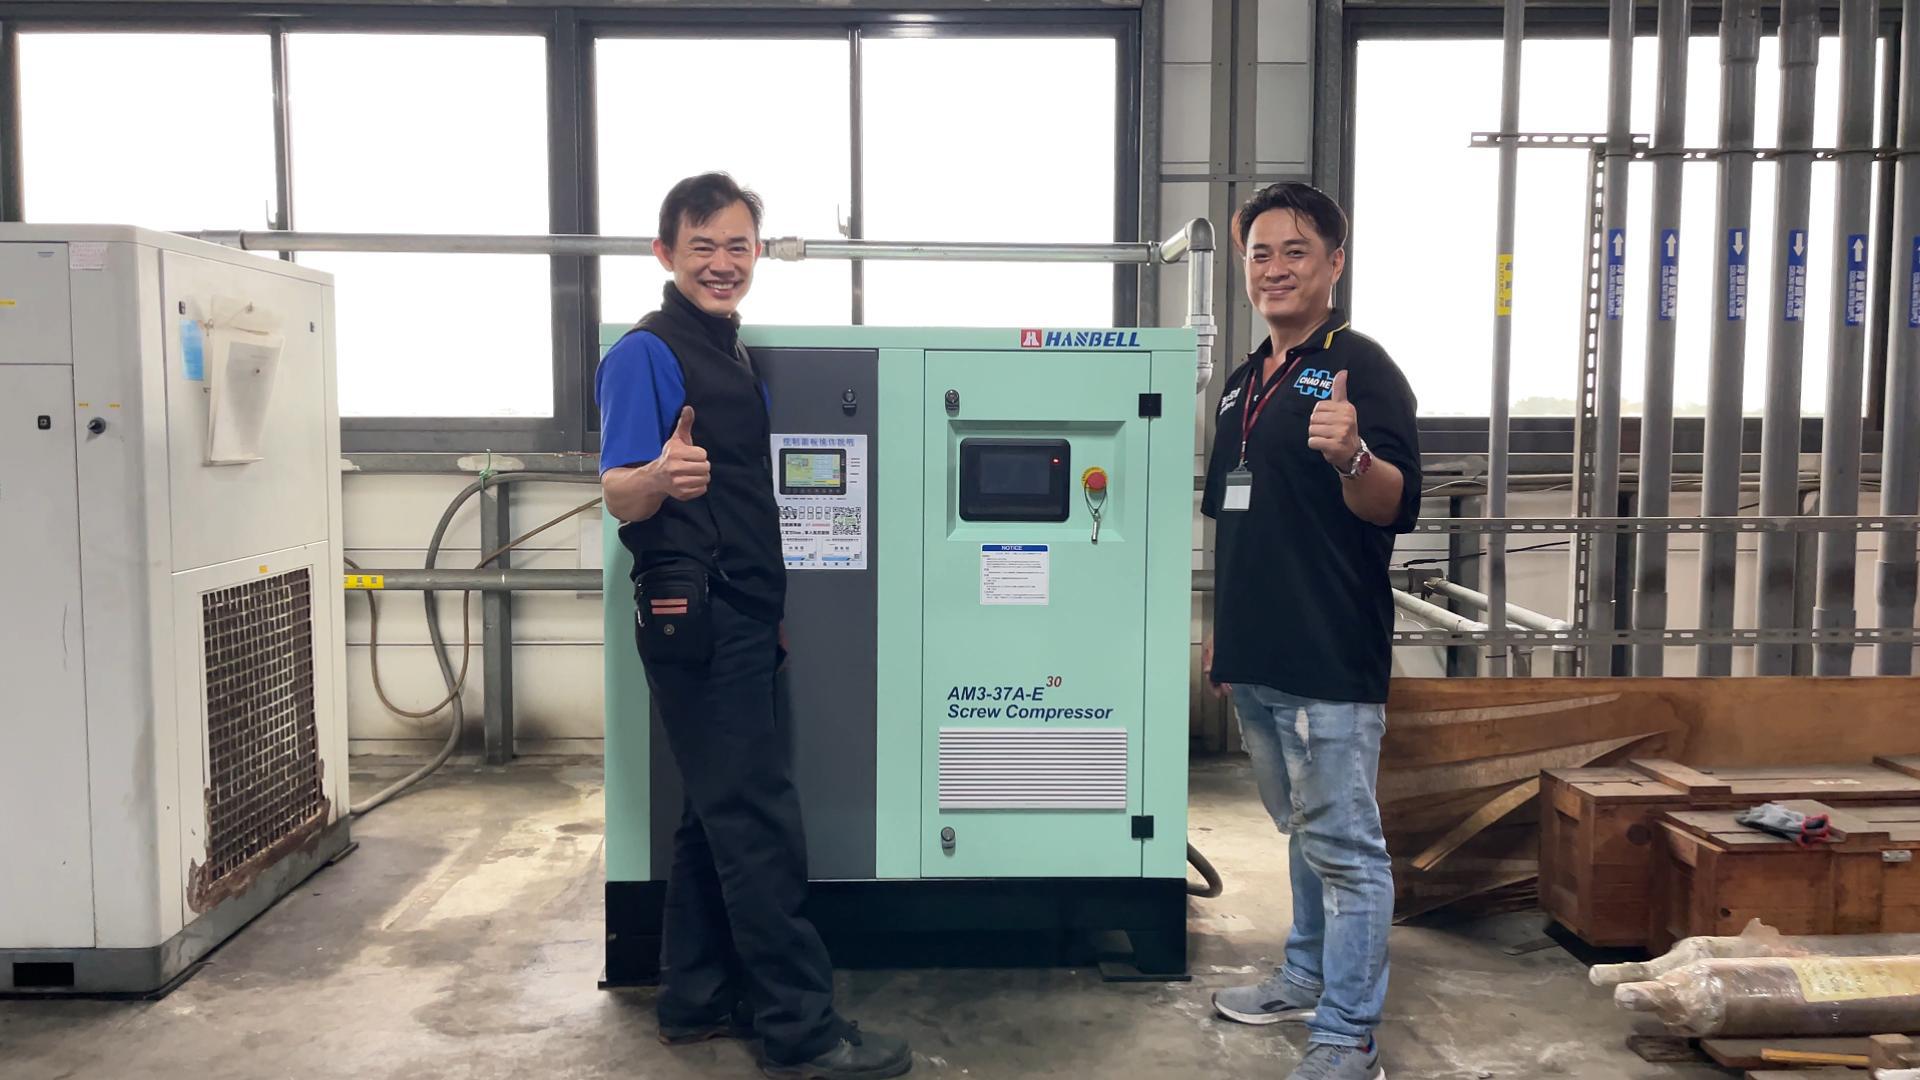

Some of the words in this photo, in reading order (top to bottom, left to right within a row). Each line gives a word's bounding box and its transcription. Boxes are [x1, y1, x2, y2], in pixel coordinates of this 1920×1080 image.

[1045, 331, 1140, 347] HANBELL
[1299, 376, 1320, 387] CHAO
[1319, 380, 1332, 389] HE
[947, 686, 1045, 701] AM3-37A-E
[947, 704, 1001, 719] Screw
[1005, 704, 1113, 722] Compressor
